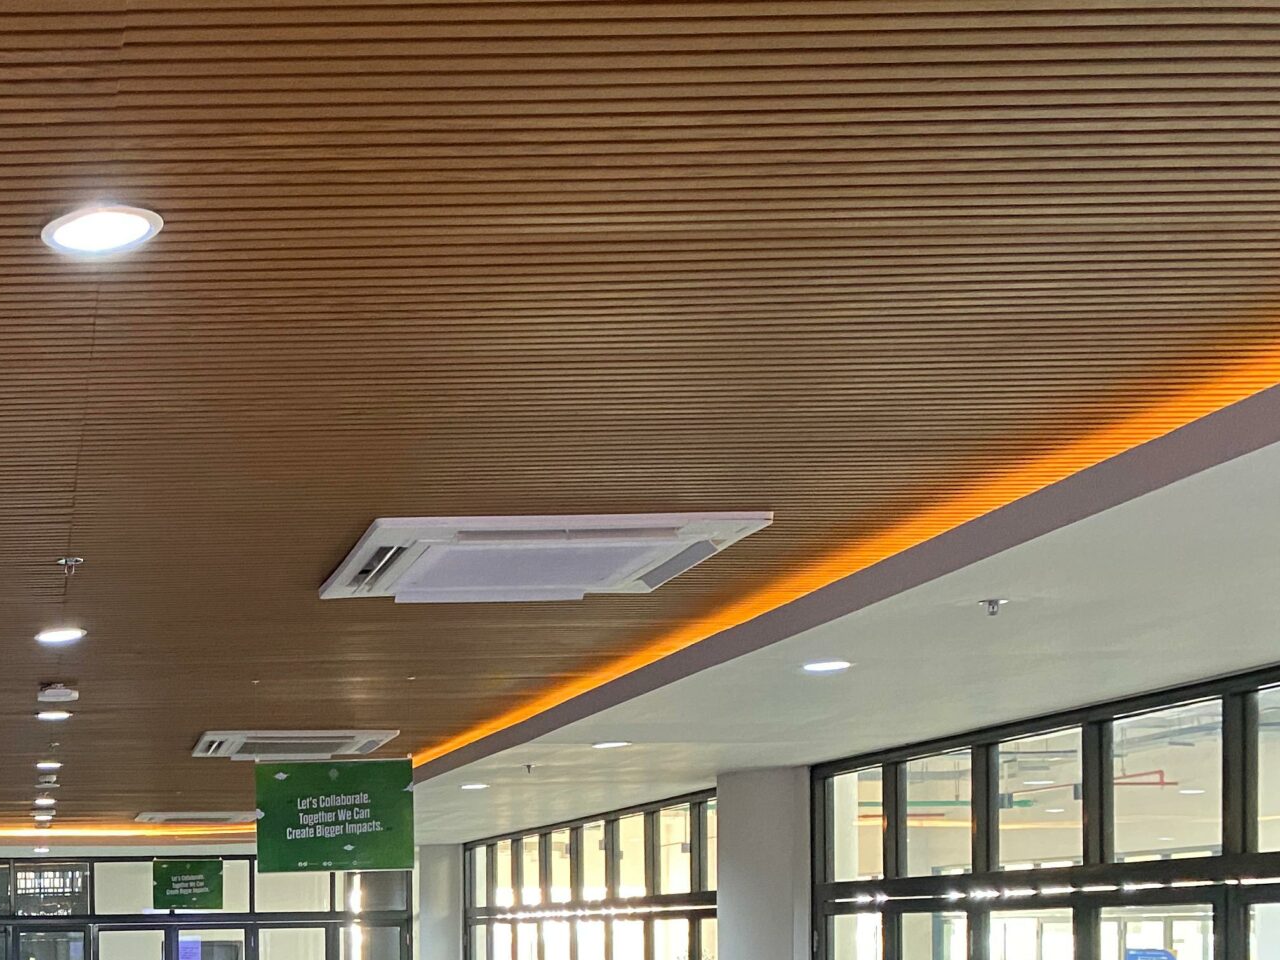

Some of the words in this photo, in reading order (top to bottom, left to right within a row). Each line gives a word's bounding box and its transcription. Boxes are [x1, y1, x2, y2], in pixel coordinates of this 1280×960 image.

[298, 796, 318, 810] Let's
[320, 792, 371, 808] Collaborate.
[299, 811, 336, 826] Together
[337, 808, 352, 820] We
[354, 808, 370, 820] Can
[286, 827, 314, 840] Create
[316, 824, 344, 838] Bigger
[346, 820, 384, 835] Impacts.
